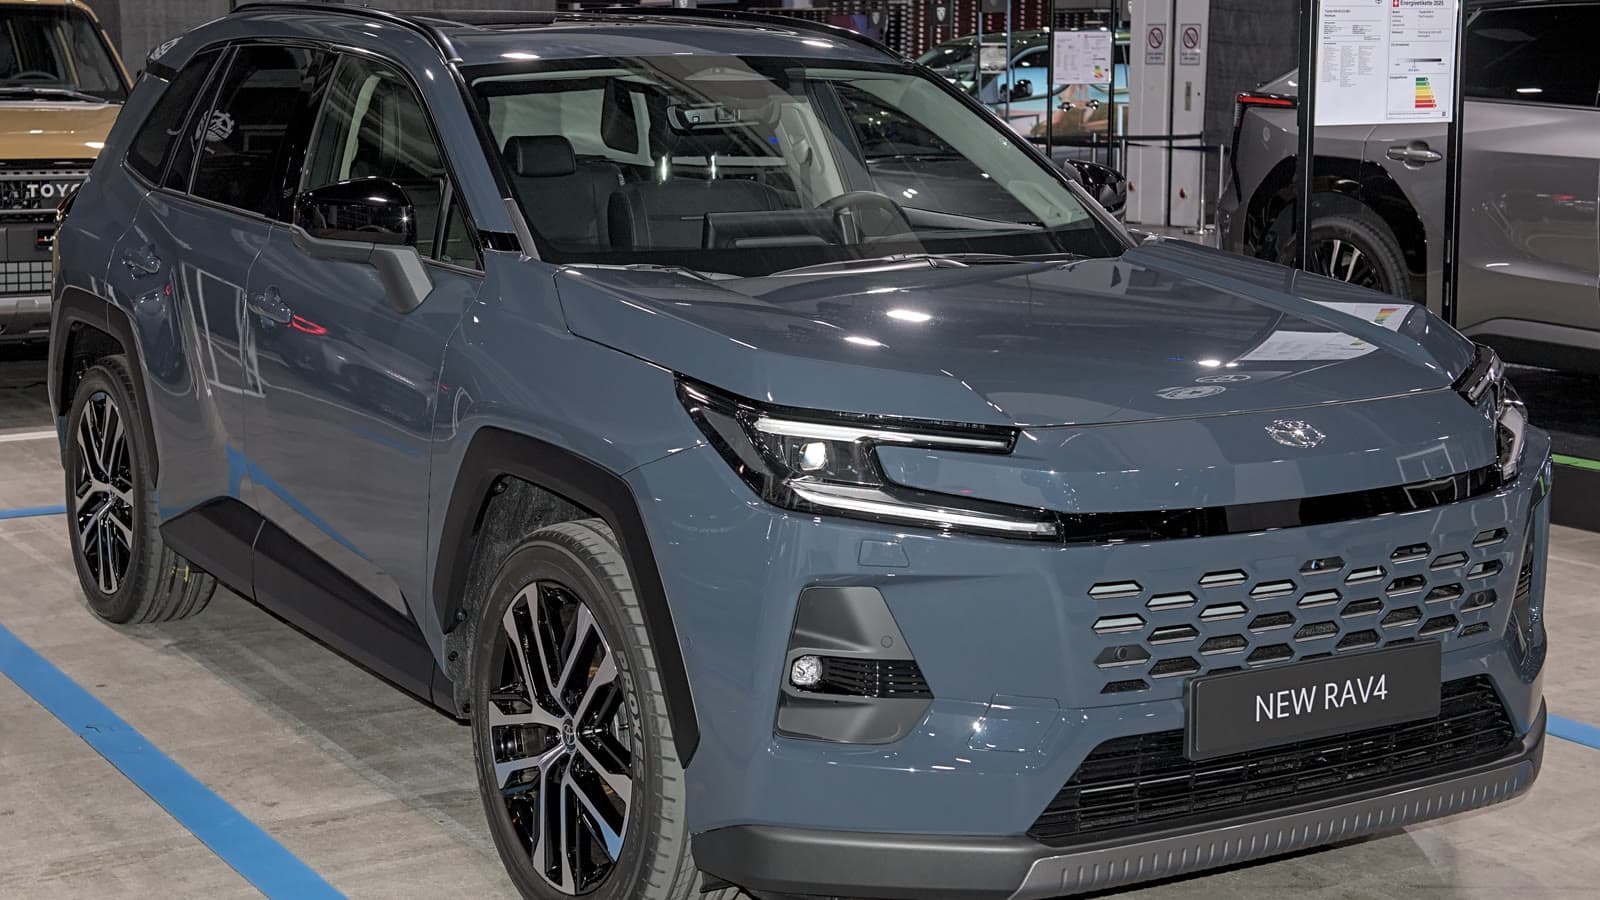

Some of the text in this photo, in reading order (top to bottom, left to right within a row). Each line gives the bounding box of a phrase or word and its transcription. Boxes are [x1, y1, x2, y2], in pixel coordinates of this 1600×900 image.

[615, 650, 645, 782] PROXES
[1256, 673, 1388, 722] NEW RAV4
